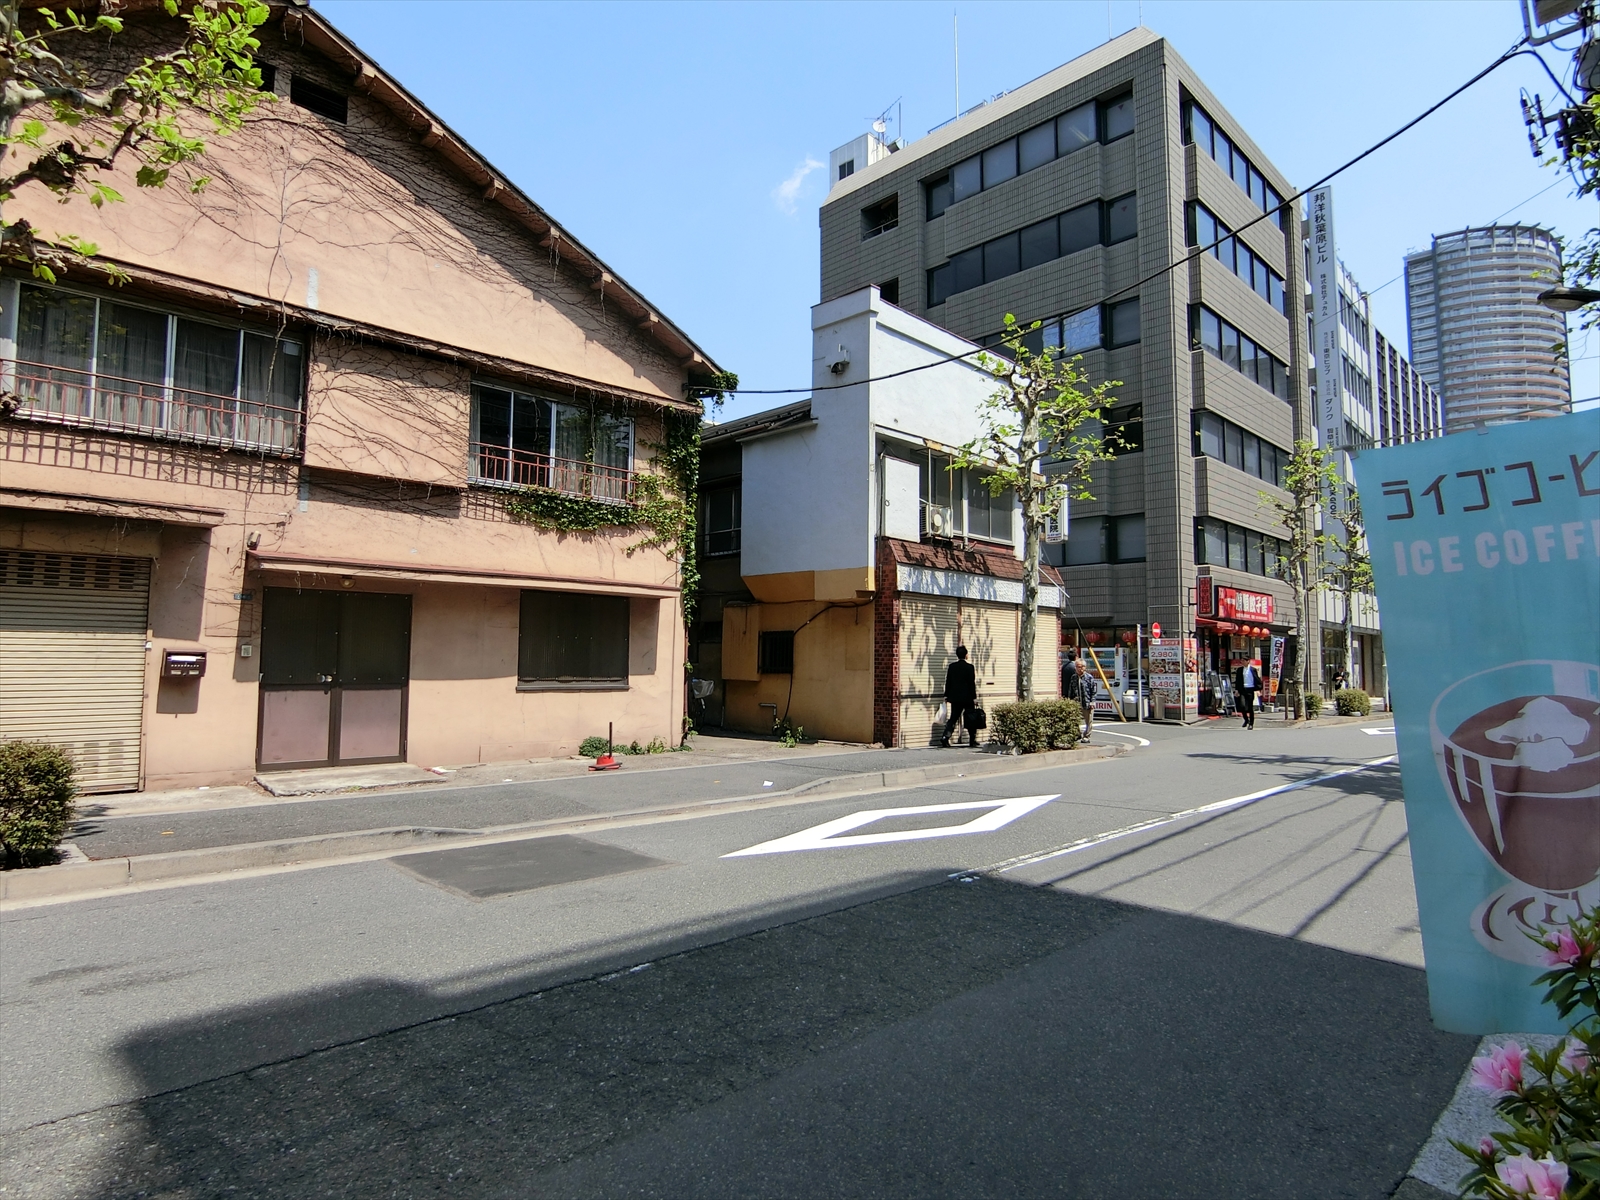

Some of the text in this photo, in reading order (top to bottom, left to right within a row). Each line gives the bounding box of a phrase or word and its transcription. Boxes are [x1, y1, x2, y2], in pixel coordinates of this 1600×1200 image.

[1314, 192, 1328, 265] 邦洋秋葉原ビル
[1392, 535, 1464, 577] ICE
[1094, 702, 1113, 710] IRIN
